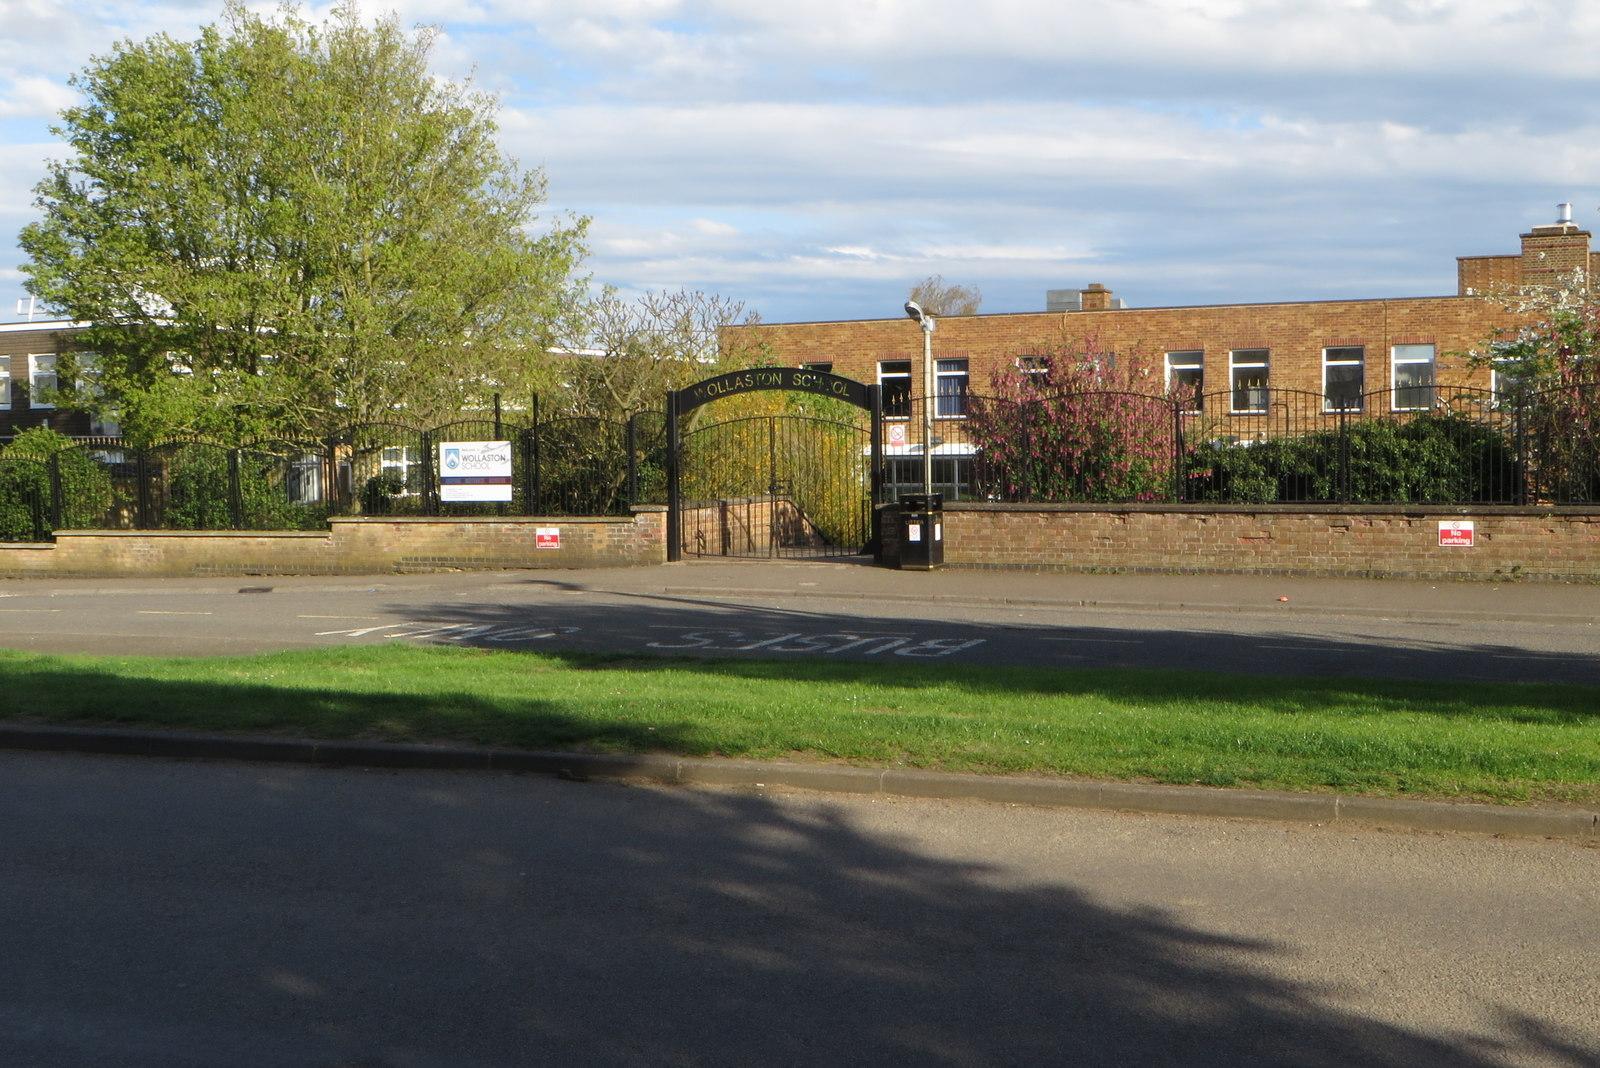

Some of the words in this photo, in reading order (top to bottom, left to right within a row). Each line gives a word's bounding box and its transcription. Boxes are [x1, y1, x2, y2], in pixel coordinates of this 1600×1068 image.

[793, 373, 850, 397] SCHOL
[462, 454, 506, 463] WOLLASTON
[1442, 537, 1471, 545] parking
